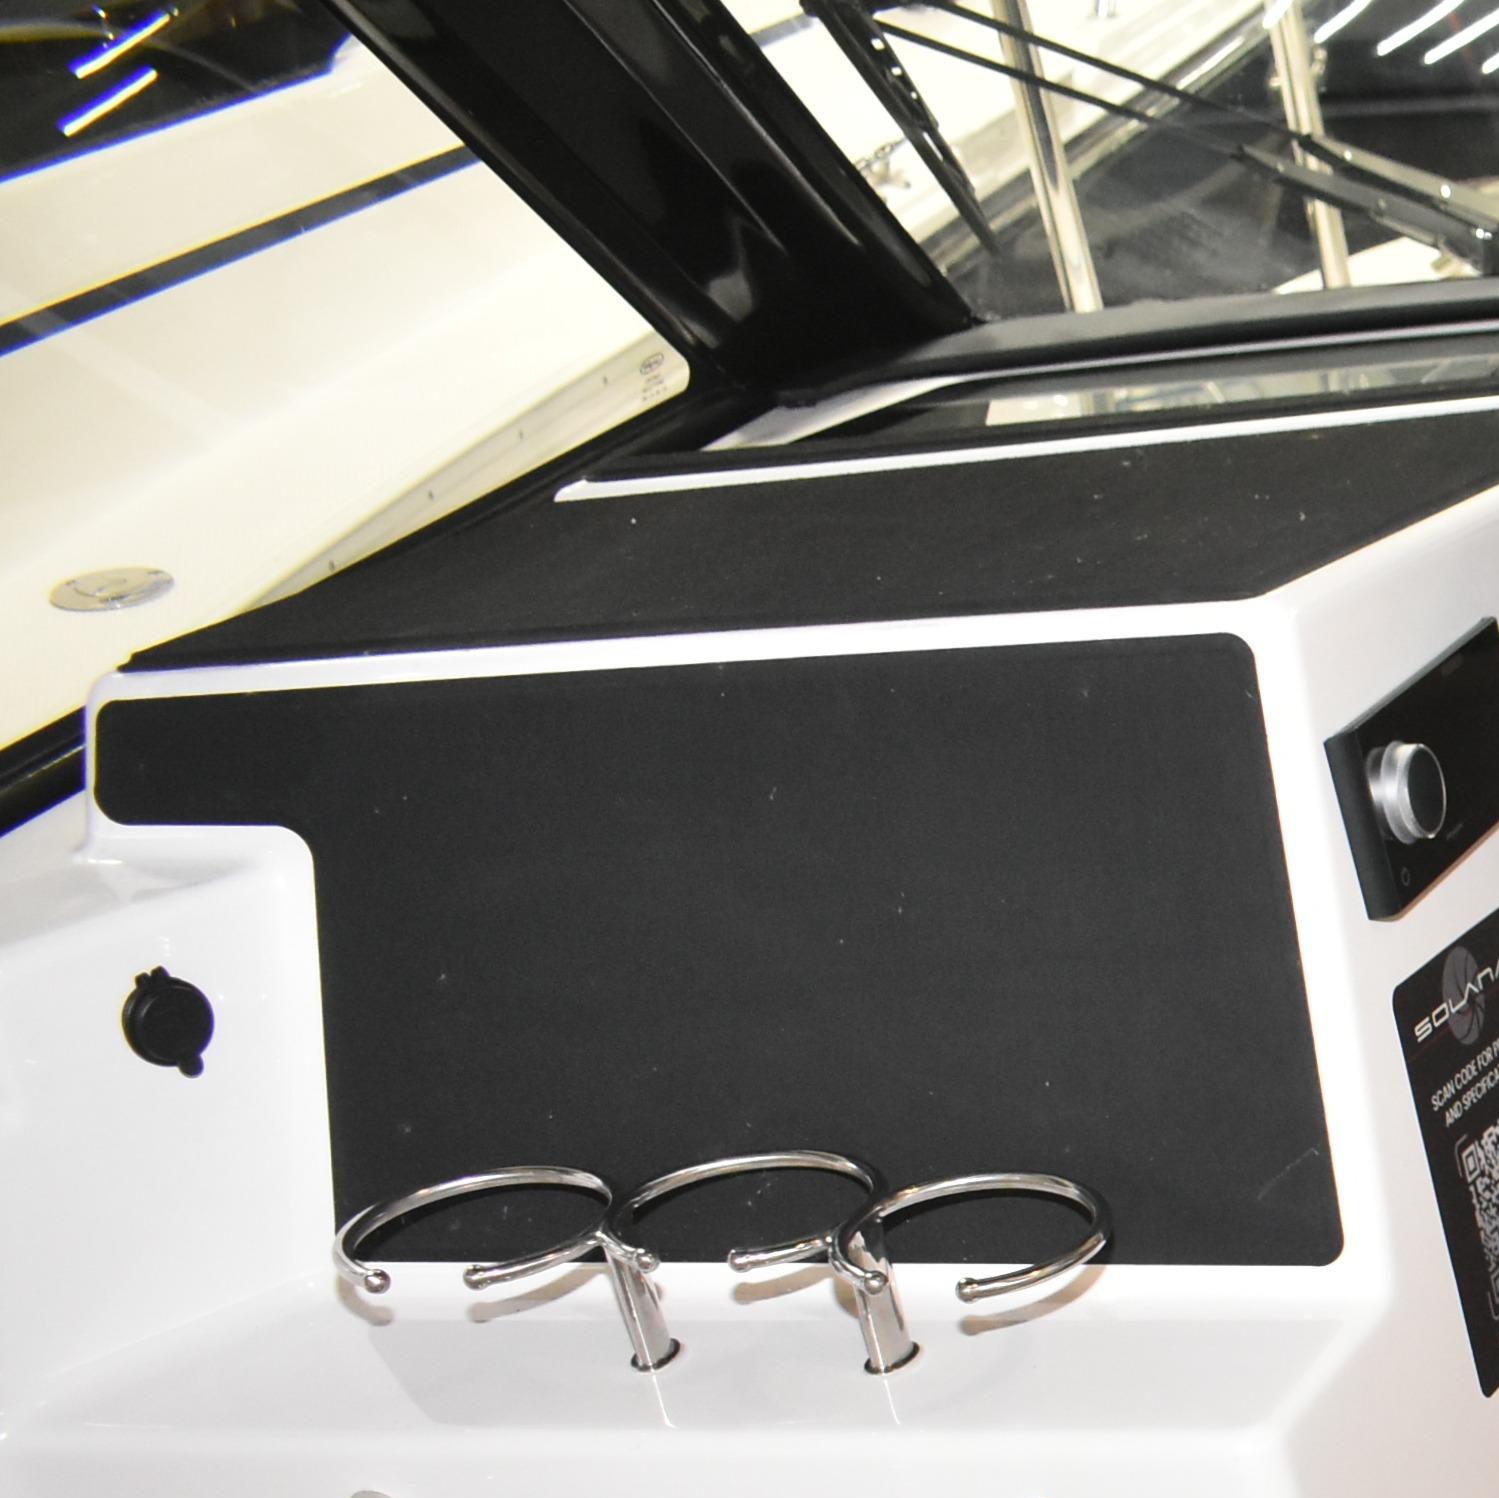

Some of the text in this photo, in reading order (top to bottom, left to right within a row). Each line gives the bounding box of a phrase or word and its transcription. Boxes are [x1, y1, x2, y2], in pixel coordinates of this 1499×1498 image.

[1431, 1080, 1455, 1112] SCAN
[1454, 1058, 1478, 1090] CODE
[1477, 1046, 1493, 1072] FOR
[1445, 1101, 1463, 1127] AND
